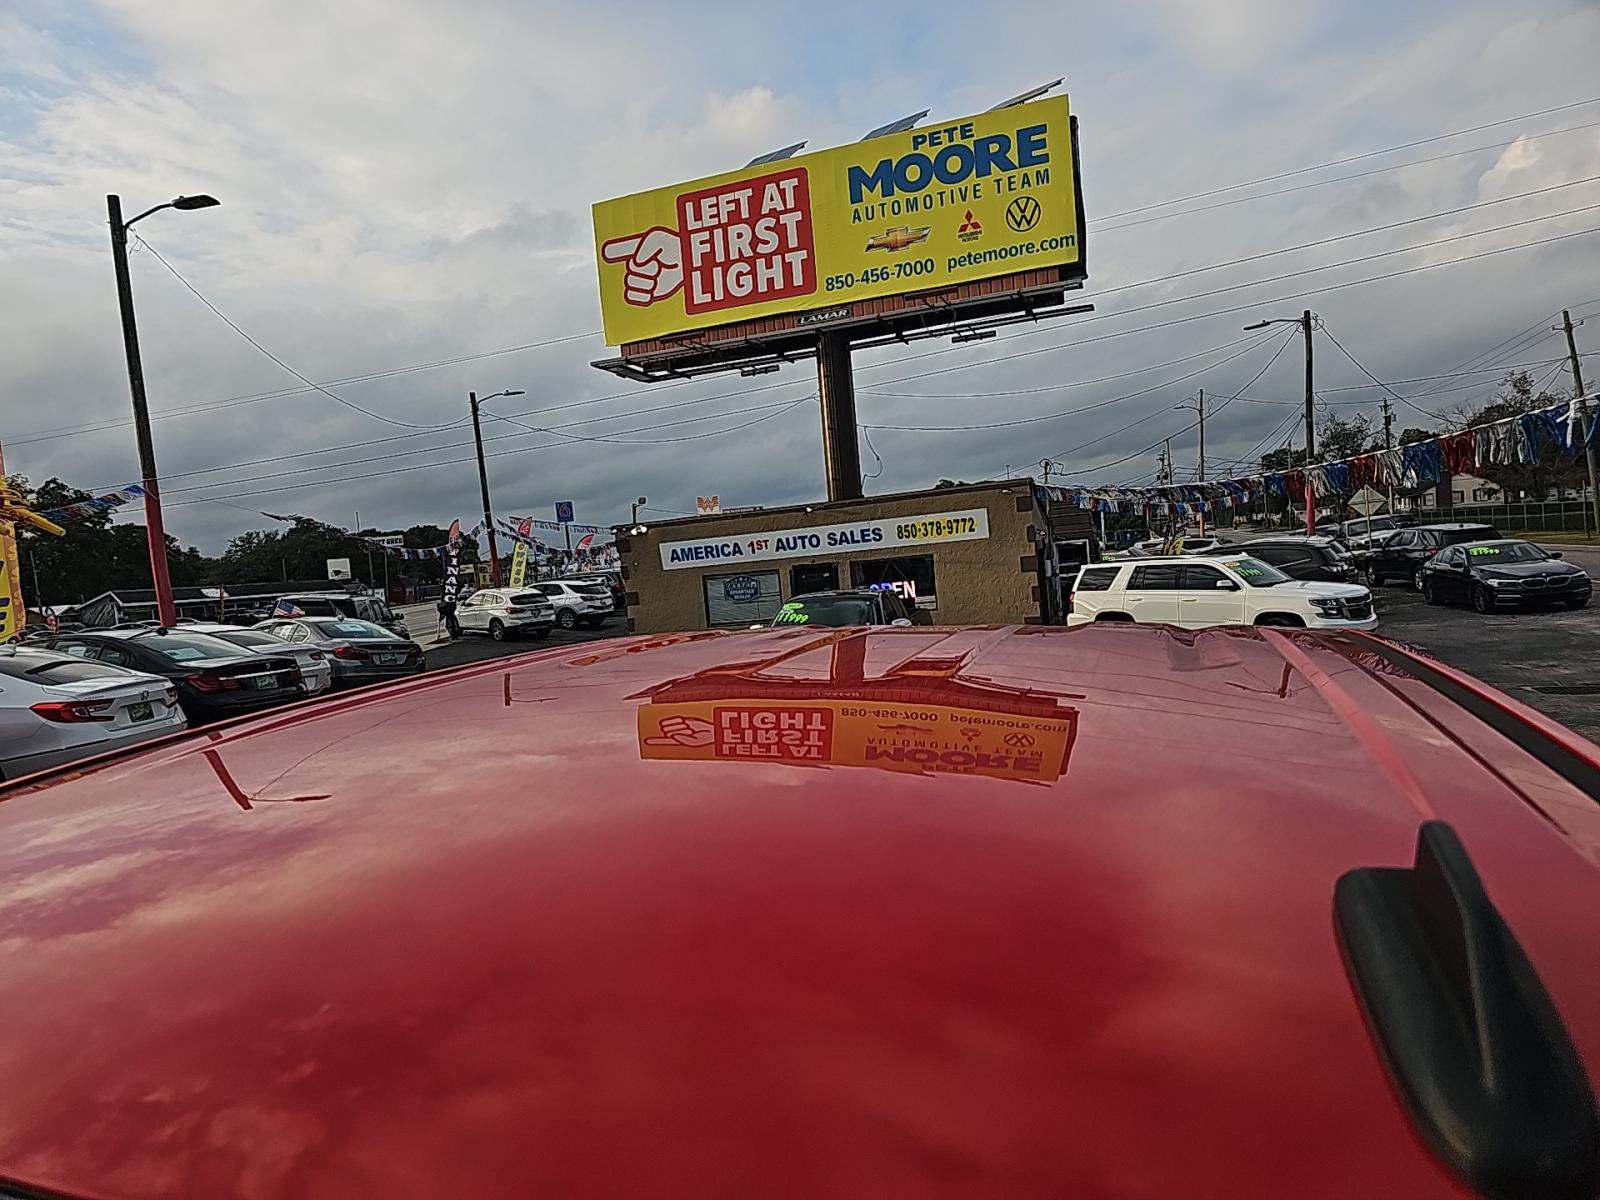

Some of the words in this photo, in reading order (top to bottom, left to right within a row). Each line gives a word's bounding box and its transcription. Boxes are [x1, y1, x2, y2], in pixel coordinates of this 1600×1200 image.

[848, 123, 1050, 205] MOORE
[912, 122, 974, 150] PETE
[685, 188, 753, 231] LEFT
[761, 177, 799, 215] AT
[852, 182, 983, 224] AUTOMOTIVE
[993, 168, 1050, 194] TEAM
[690, 210, 803, 268] FIRST
[825, 258, 935, 292] 850-456-7000
[947, 233, 1076, 273] petemoore.com
[691, 249, 808, 305] LIGHT
[800, 309, 848, 324] LAMAR
[670, 542, 744, 563] AMERICA
[747, 539, 770, 555] 1ST
[775, 533, 821, 552] AUTO
[827, 527, 883, 546] SALES
